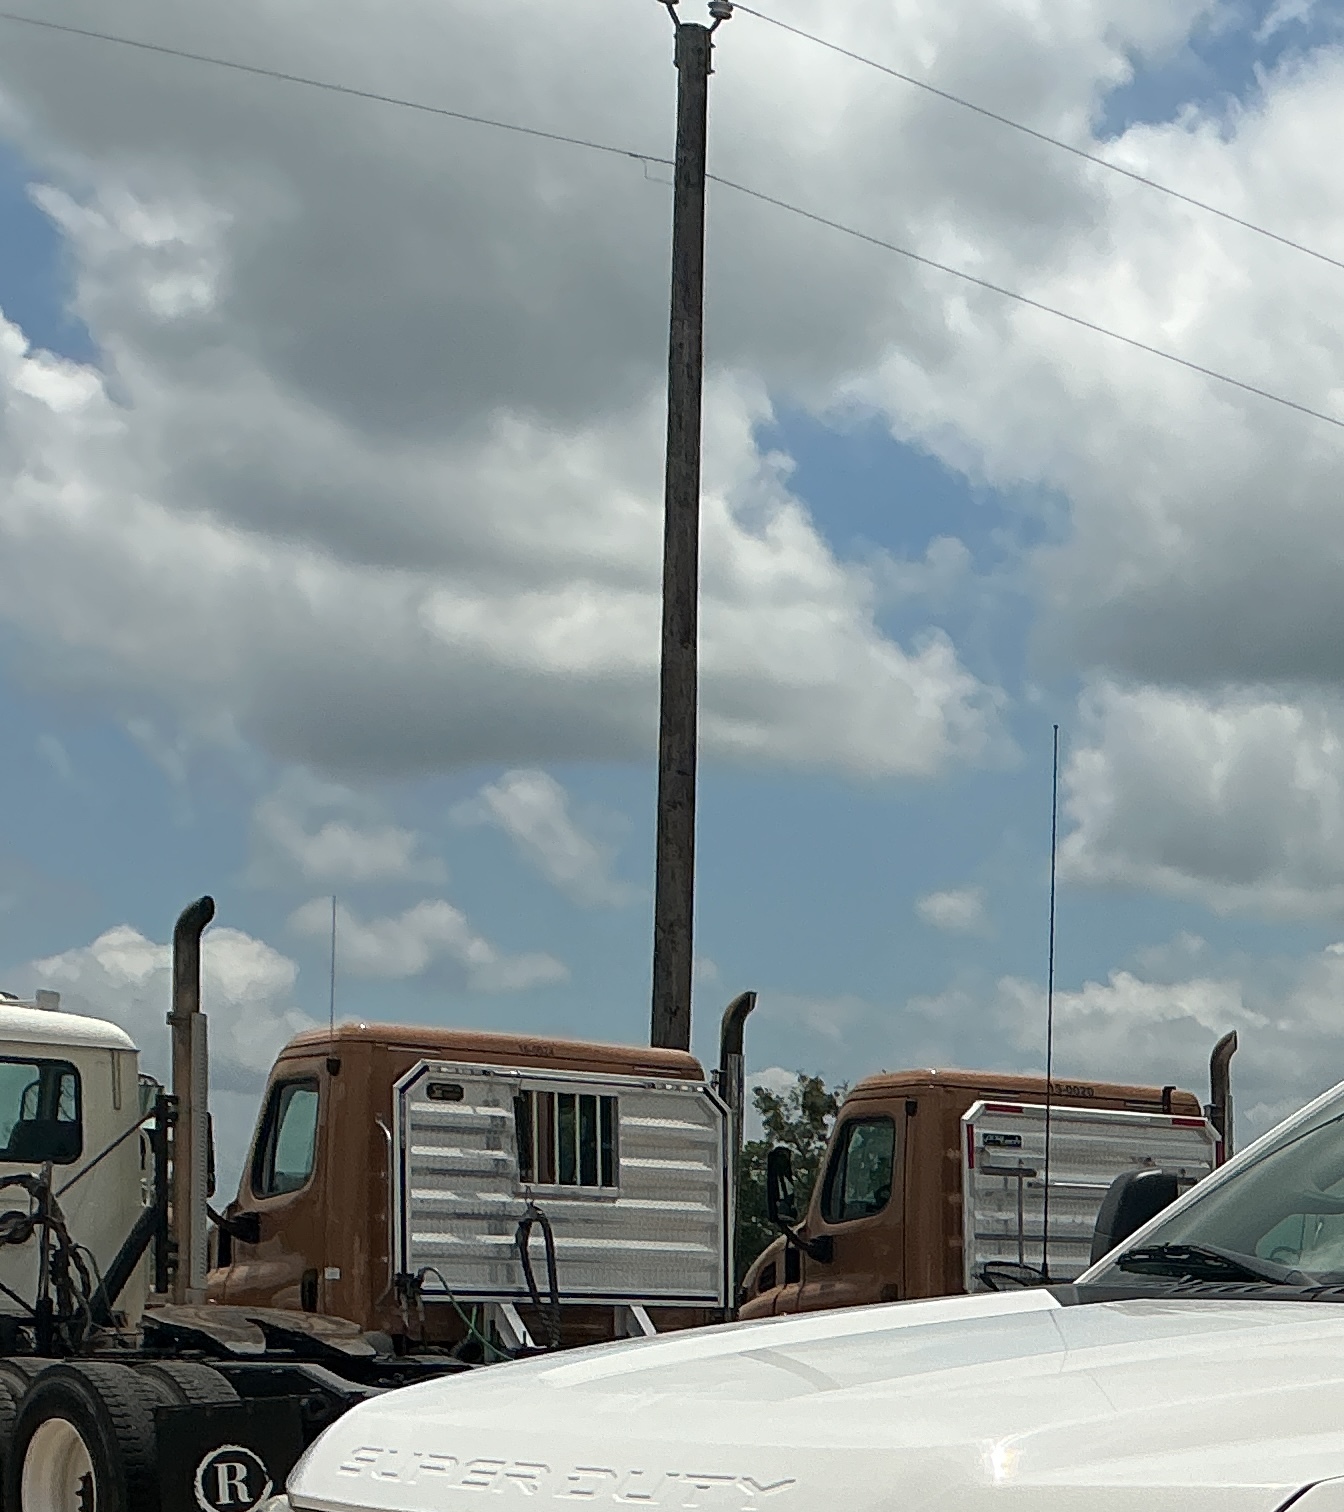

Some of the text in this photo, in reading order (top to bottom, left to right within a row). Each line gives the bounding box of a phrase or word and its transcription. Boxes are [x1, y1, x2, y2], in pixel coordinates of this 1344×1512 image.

[212, 1461, 254, 1505] R
[336, 1446, 797, 1512] SUPER DUTY
